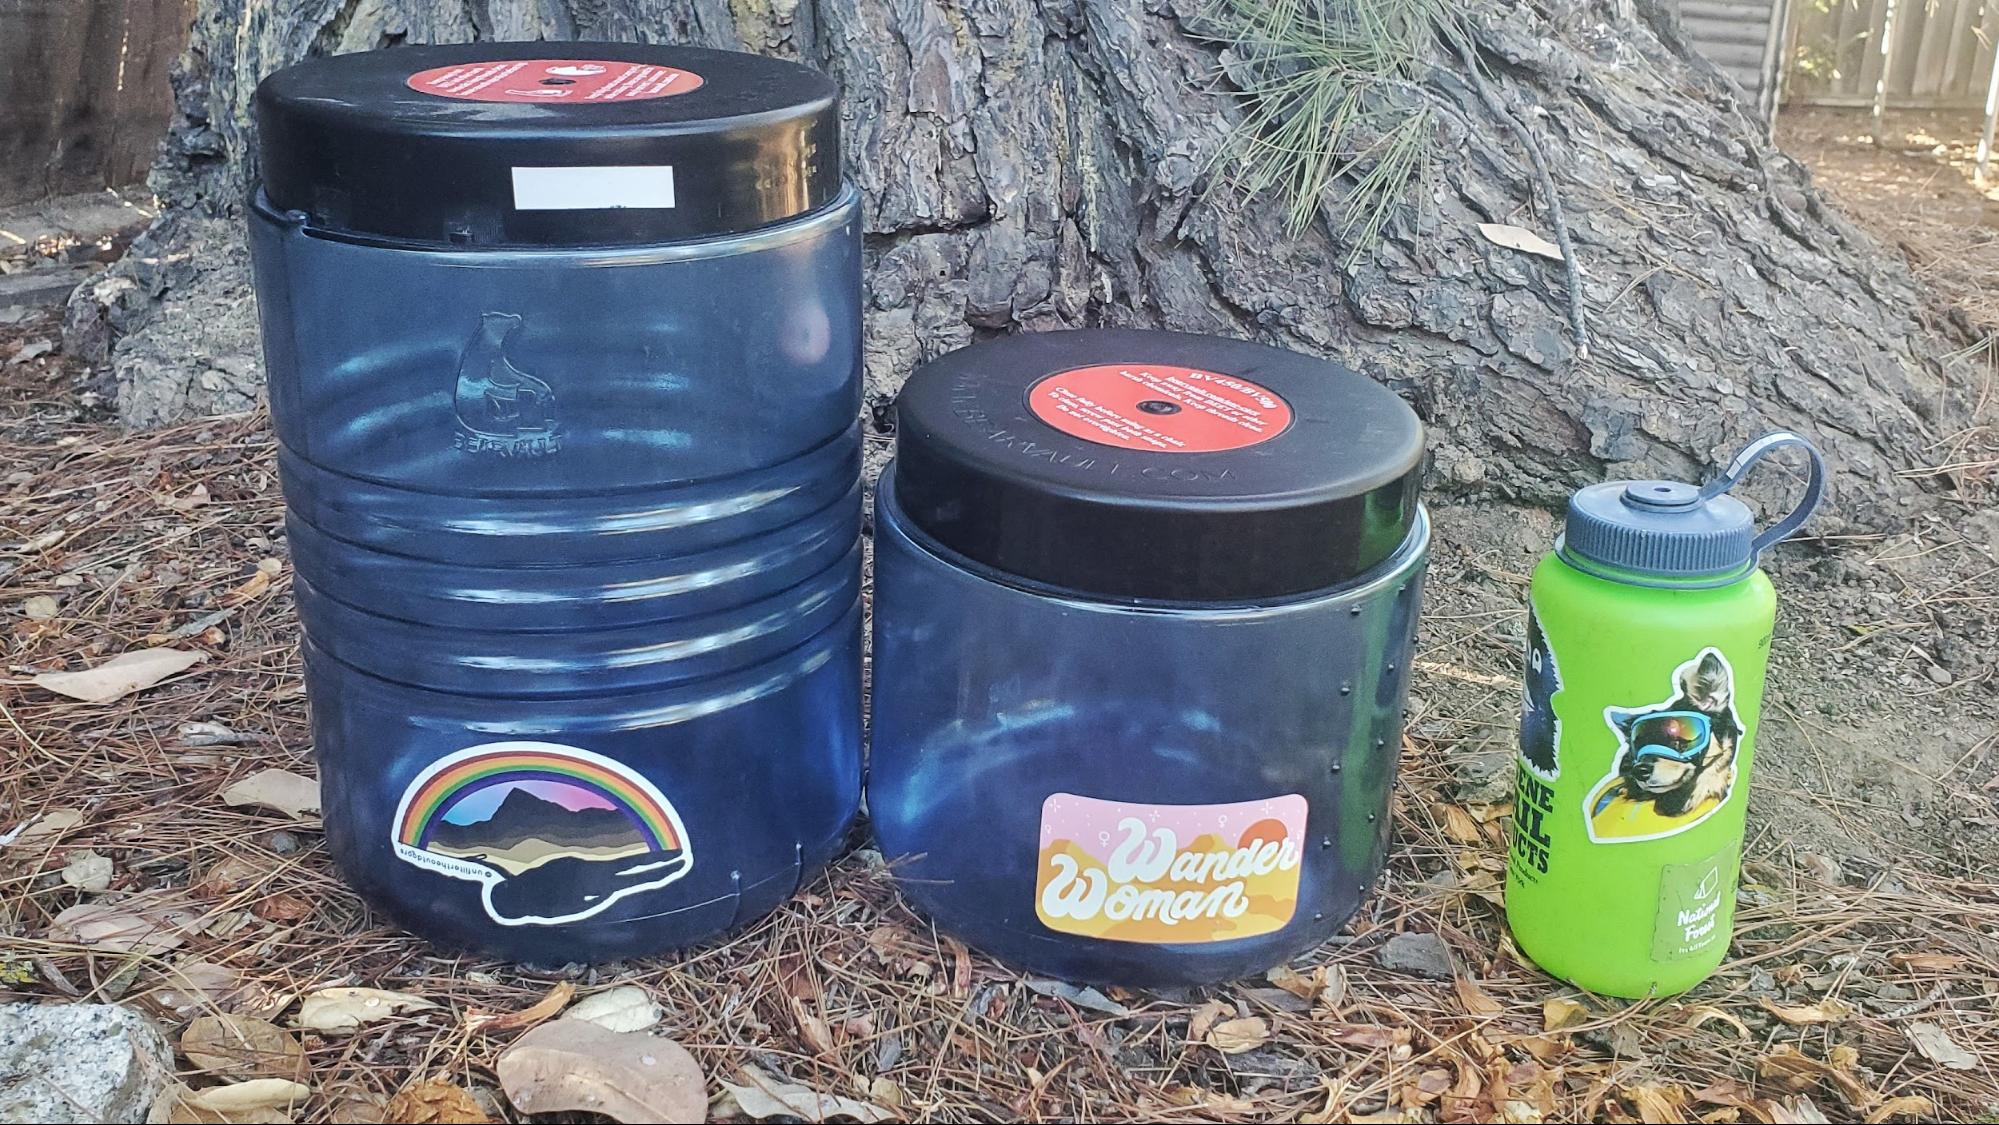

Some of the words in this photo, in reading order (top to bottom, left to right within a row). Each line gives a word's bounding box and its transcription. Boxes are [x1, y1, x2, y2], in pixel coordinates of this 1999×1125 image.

[1516, 764, 1555, 813] ENE
[1107, 817, 1300, 884] Wander
[1042, 853, 1249, 926] Woman
[1677, 890, 1721, 926] National
